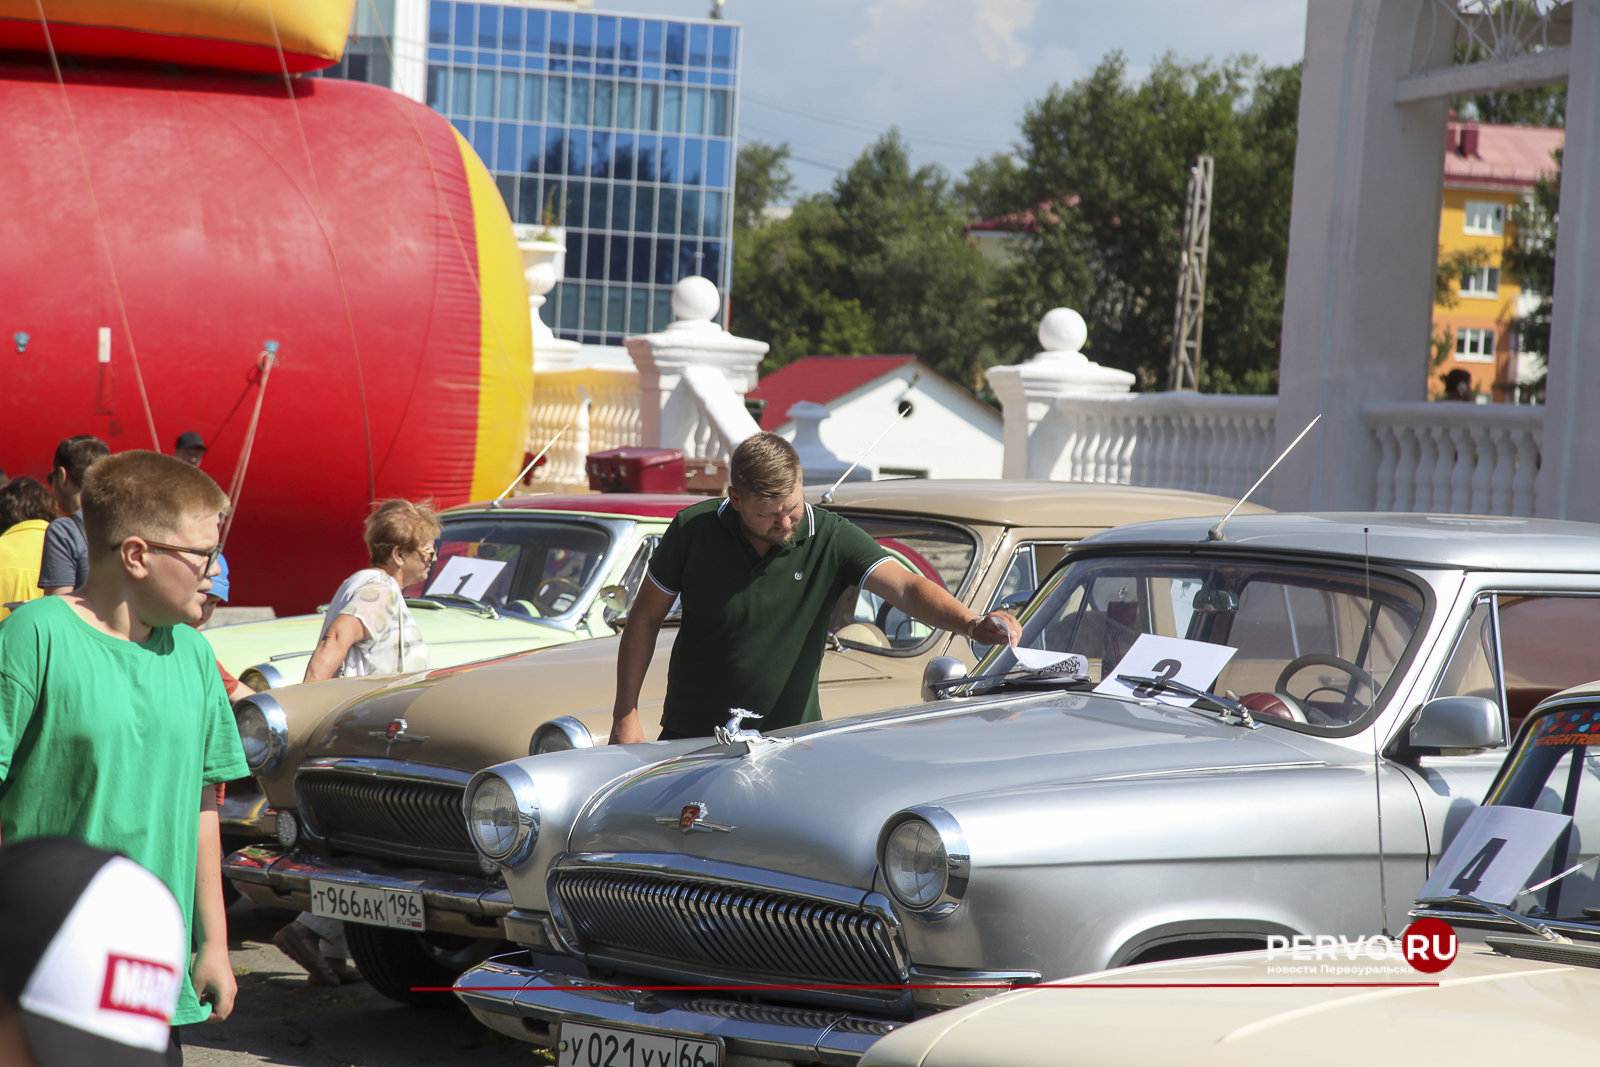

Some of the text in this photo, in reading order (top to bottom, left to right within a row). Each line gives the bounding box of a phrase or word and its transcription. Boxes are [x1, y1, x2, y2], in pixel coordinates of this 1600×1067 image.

[453, 573, 474, 594] 1
[1132, 658, 1182, 699] 3
[1449, 837, 1508, 896] 4
[388, 893, 419, 916] 196
[396, 916, 412, 926] RUS
